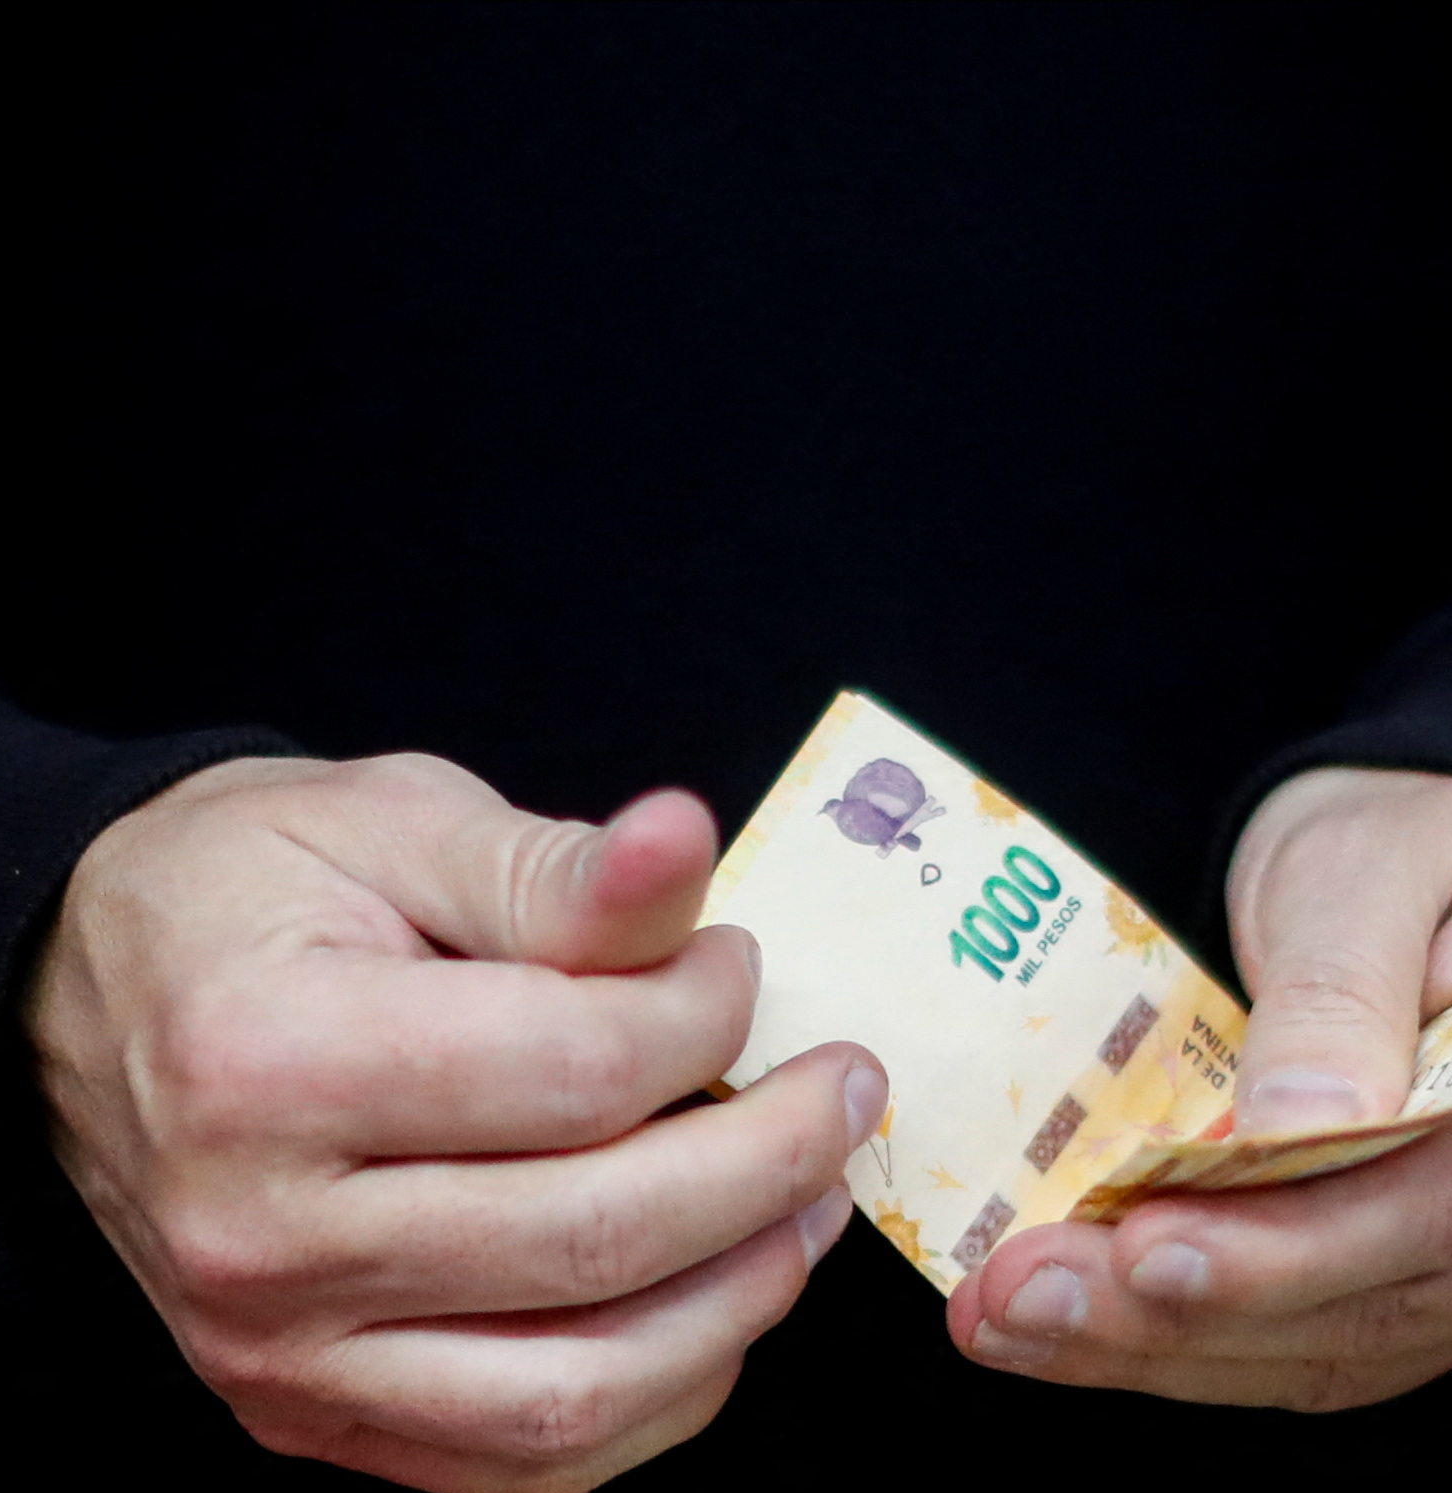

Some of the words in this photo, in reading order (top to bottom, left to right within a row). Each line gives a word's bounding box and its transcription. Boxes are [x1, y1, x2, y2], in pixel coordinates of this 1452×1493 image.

[947, 845, 1062, 984] 1000
[1015, 954, 1043, 988] MIL
[1036, 896, 1082, 956] PESOS
